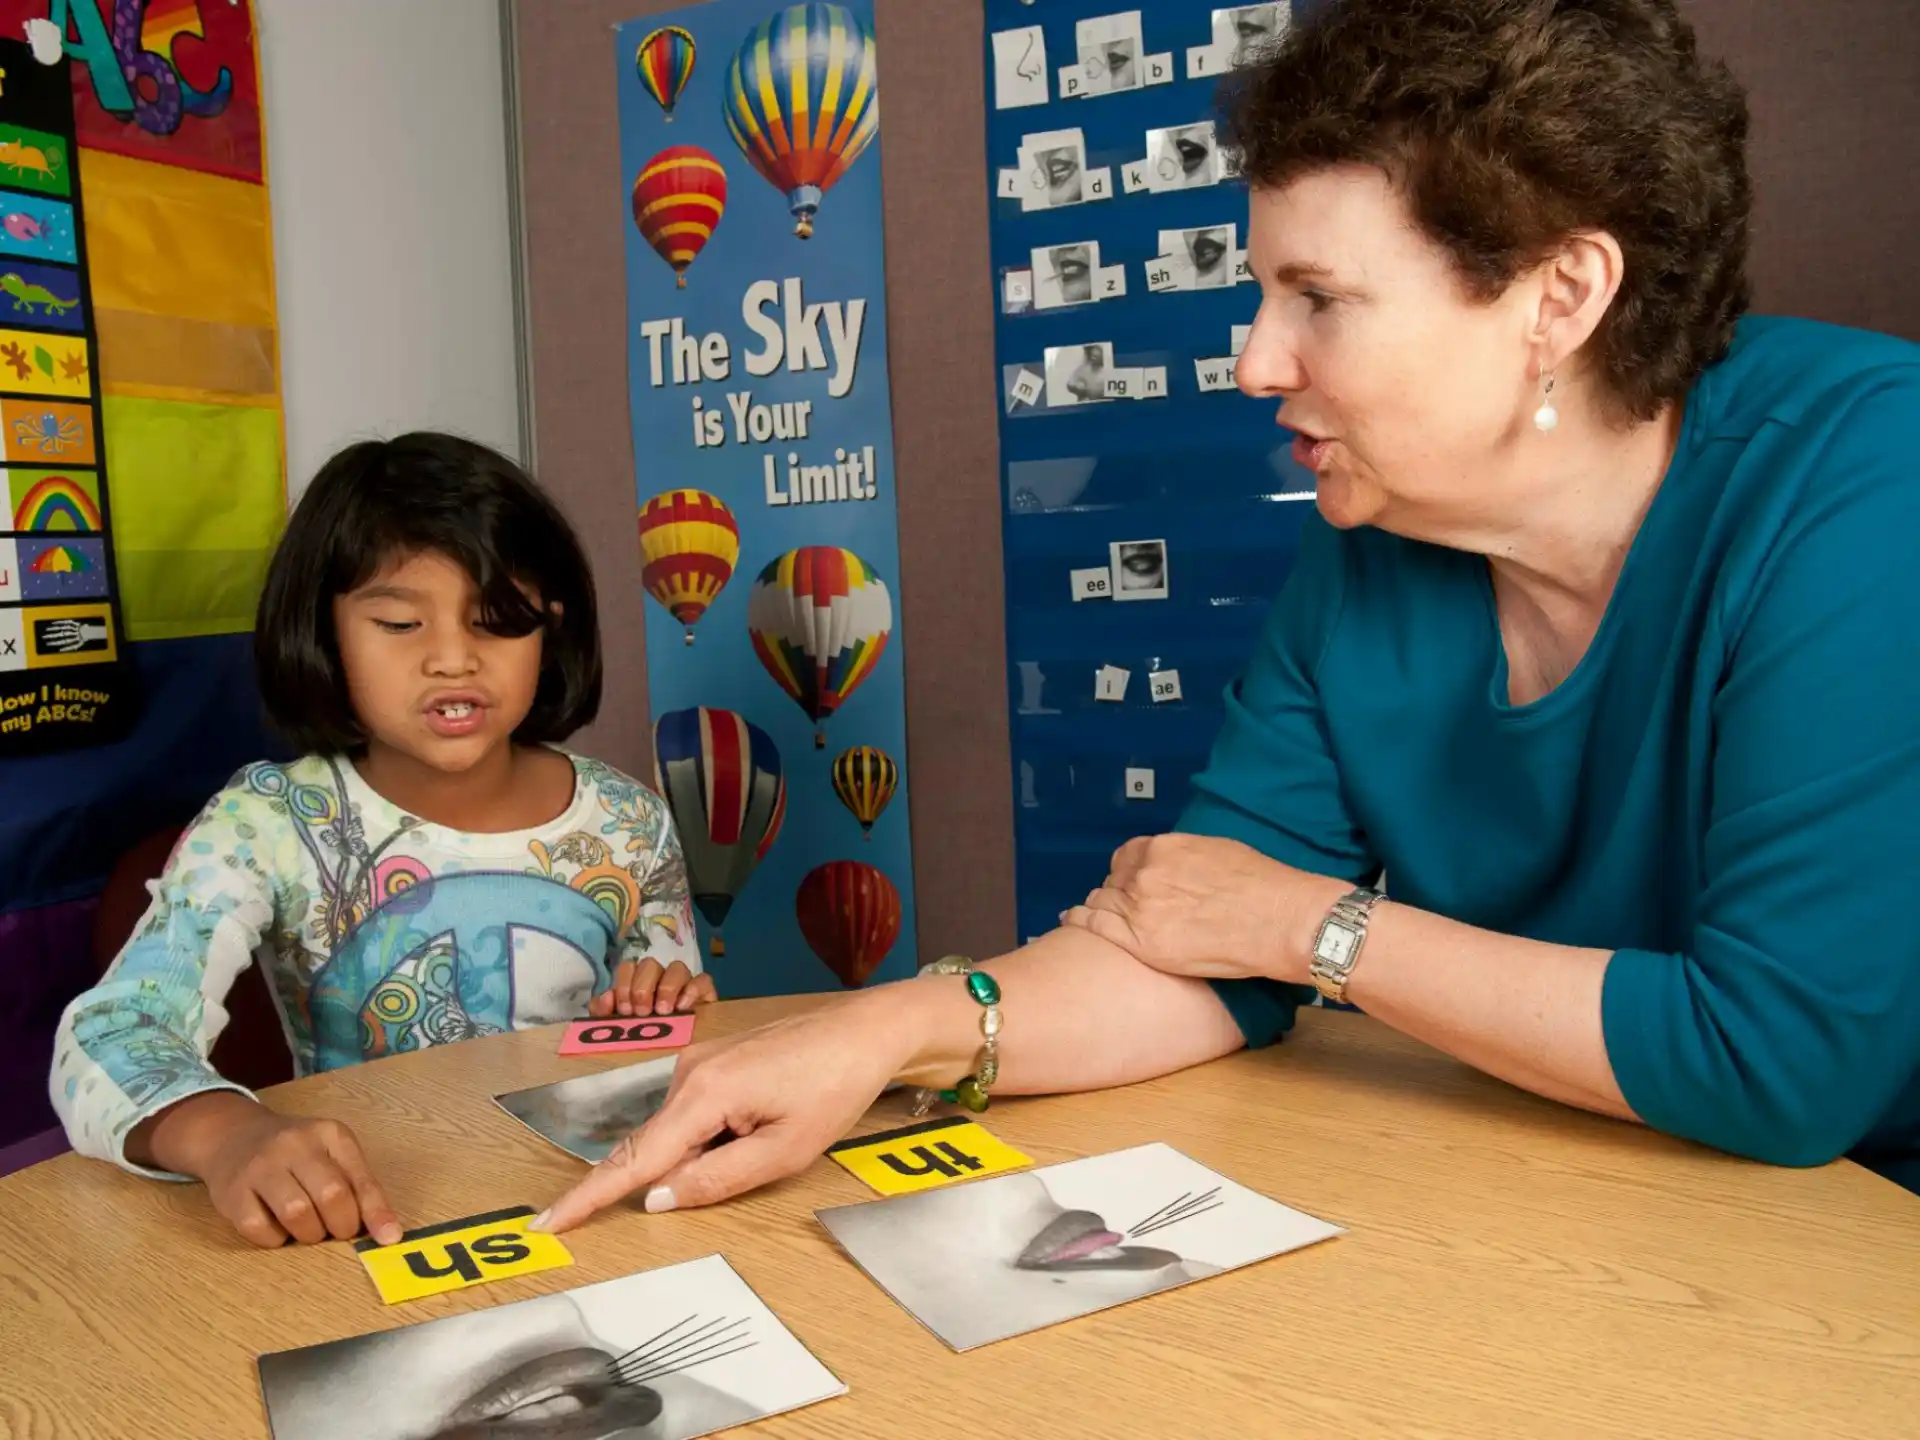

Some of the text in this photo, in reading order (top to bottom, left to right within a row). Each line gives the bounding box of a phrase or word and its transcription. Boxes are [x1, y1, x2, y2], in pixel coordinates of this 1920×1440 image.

[1152, 62, 1163, 78] b
[1068, 77, 1078, 94] p
[1131, 170, 1142, 185] k
[1092, 179, 1102, 193] d
[1150, 269, 1171, 285] sh
[1013, 284, 1023, 296] s
[1106, 280, 1115, 291] z
[641, 276, 867, 399] The Sky
[1018, 382, 1034, 398] m
[1107, 379, 1127, 396] ng
[1148, 379, 1157, 390] n
[692, 391, 812, 448] is Your
[763, 446, 878, 507] Limit!
[1086, 578, 1106, 592] ee
[55, 684, 111, 705] know
[1155, 682, 1174, 695] ae
[1, 704, 97, 733] my ABCs!
[1134, 780, 1144, 792] e
[876, 1141, 986, 1178] th
[402, 1233, 531, 1282] sh
